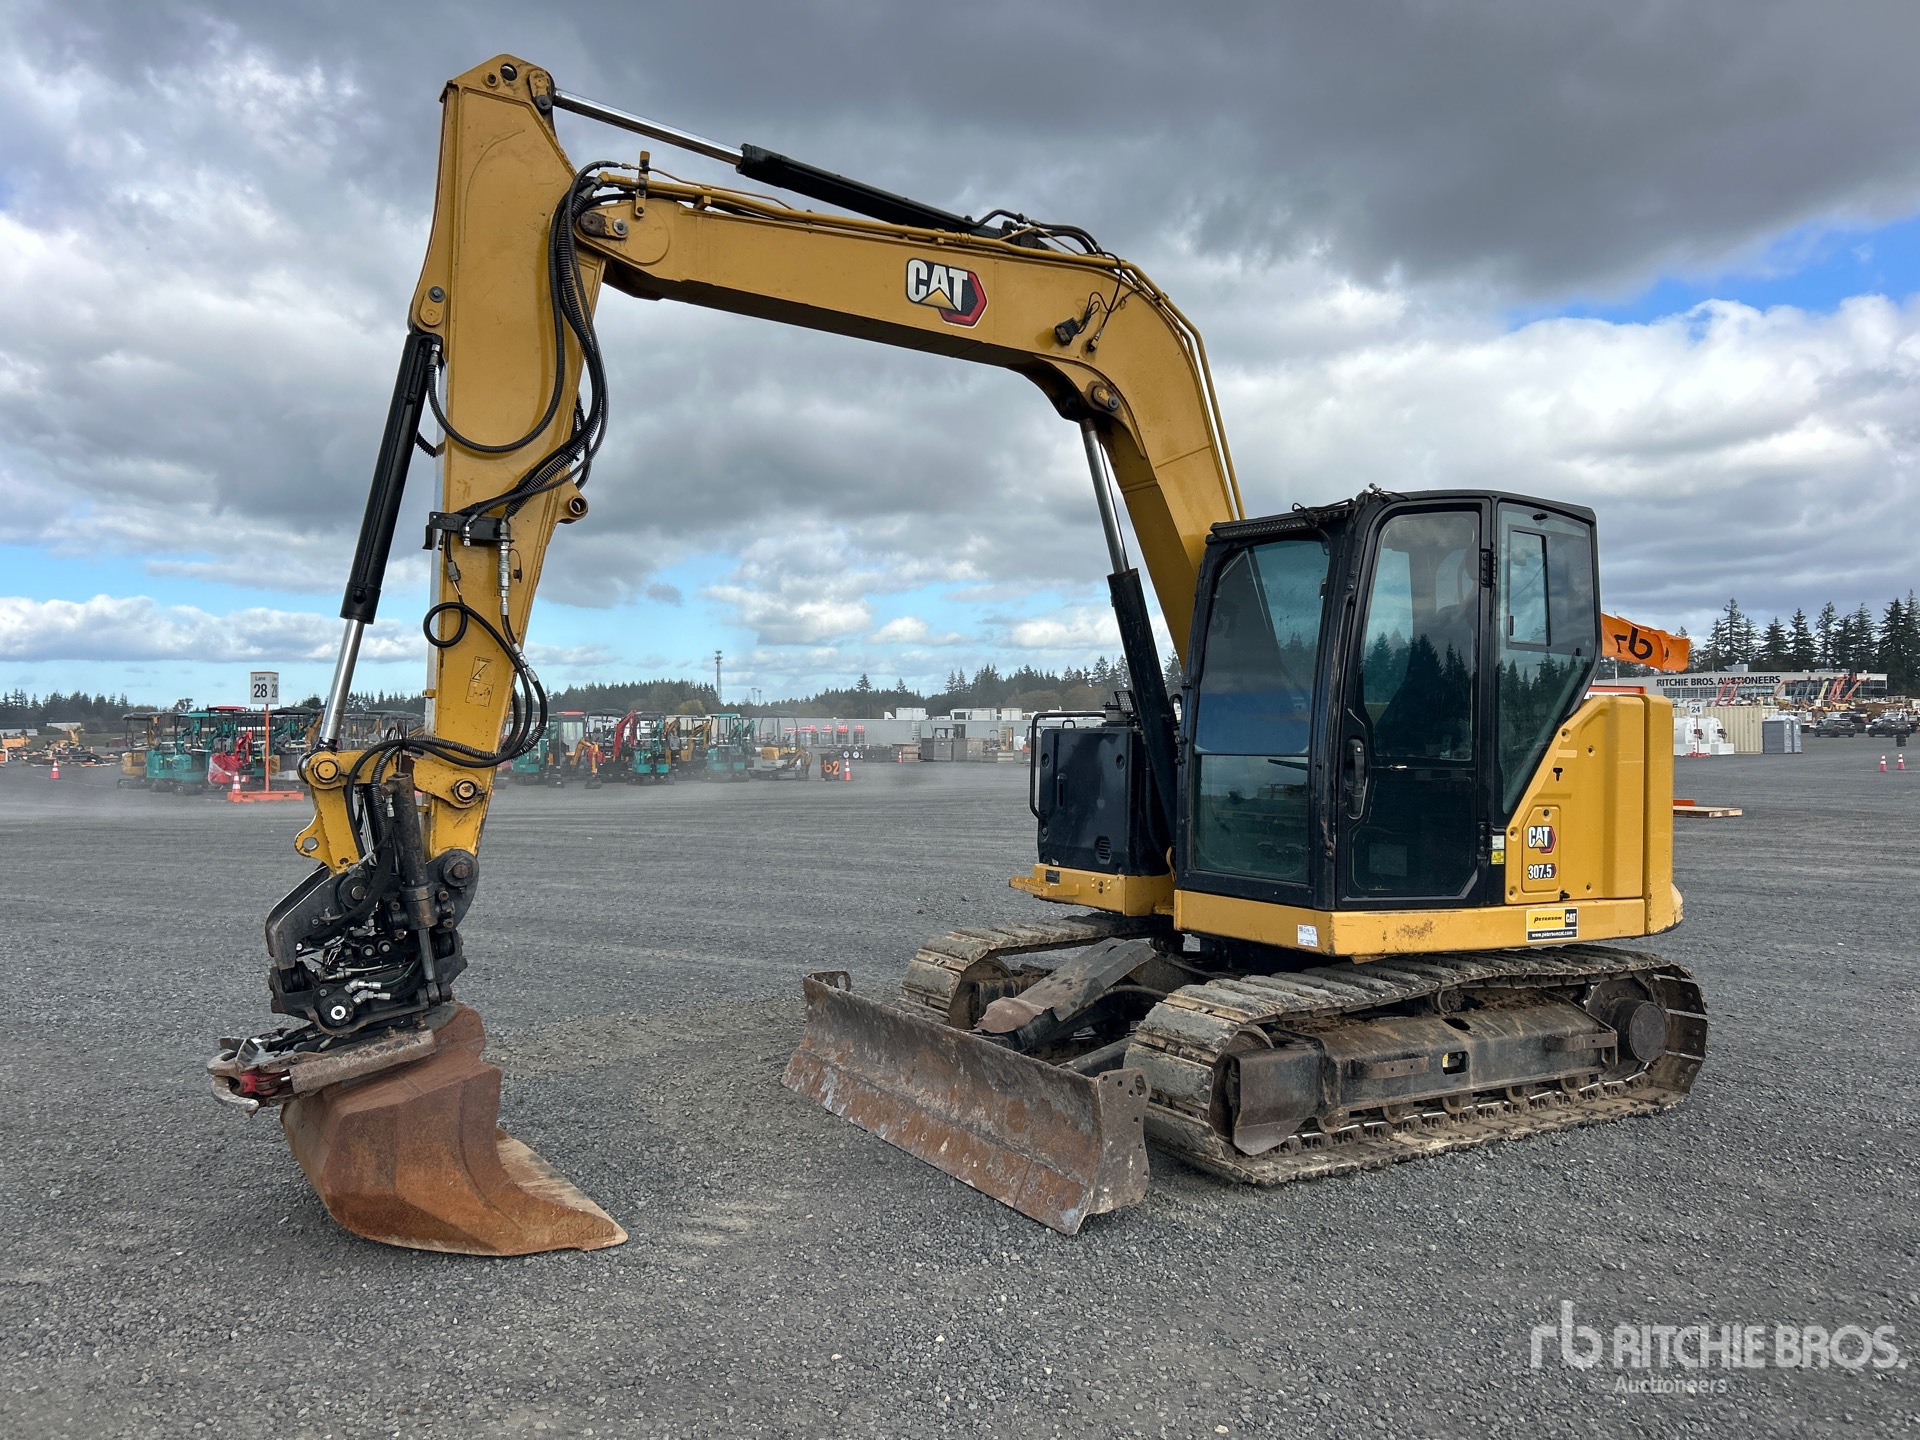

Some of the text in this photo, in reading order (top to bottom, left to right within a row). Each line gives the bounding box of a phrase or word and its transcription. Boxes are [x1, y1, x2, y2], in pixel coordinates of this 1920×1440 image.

[907, 259, 968, 311] CAT
[1656, 675, 1781, 687] RITCHIE BROS. AUCTIONEERS
[253, 683, 268, 698] 28
[1528, 827, 1549, 847] CAT
[1528, 864, 1552, 879] 307.5
[1566, 913, 1576, 923] CAT
